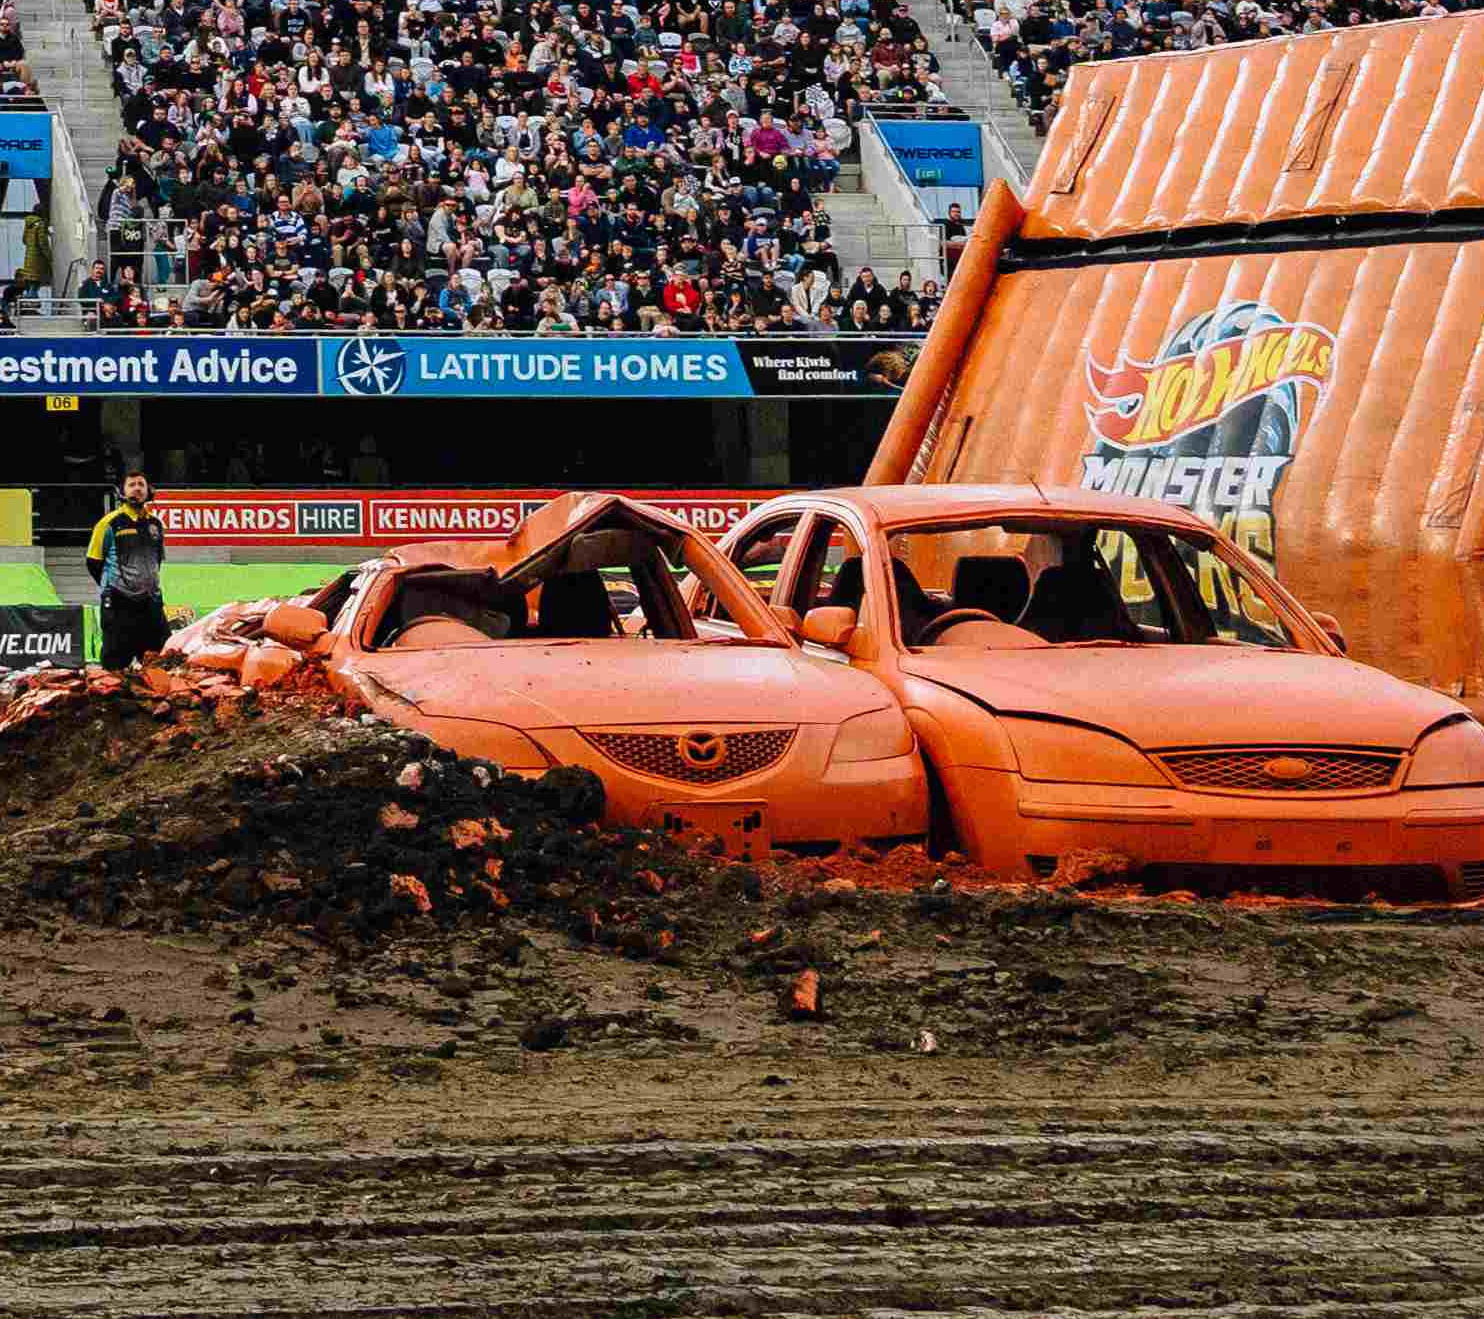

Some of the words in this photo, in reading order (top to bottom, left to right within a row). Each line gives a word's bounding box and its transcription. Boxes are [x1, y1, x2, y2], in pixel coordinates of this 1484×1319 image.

[168, 347, 298, 384] Advice
[420, 352, 581, 382] LATITUDE
[594, 352, 729, 382] HOMES
[777, 369, 804, 381] find
[805, 369, 858, 381] comfort
[52, 396, 72, 410] 06
[150, 507, 292, 533] KENNARDS
[300, 504, 358, 533] HIRE
[376, 507, 518, 530] KENNARDS
